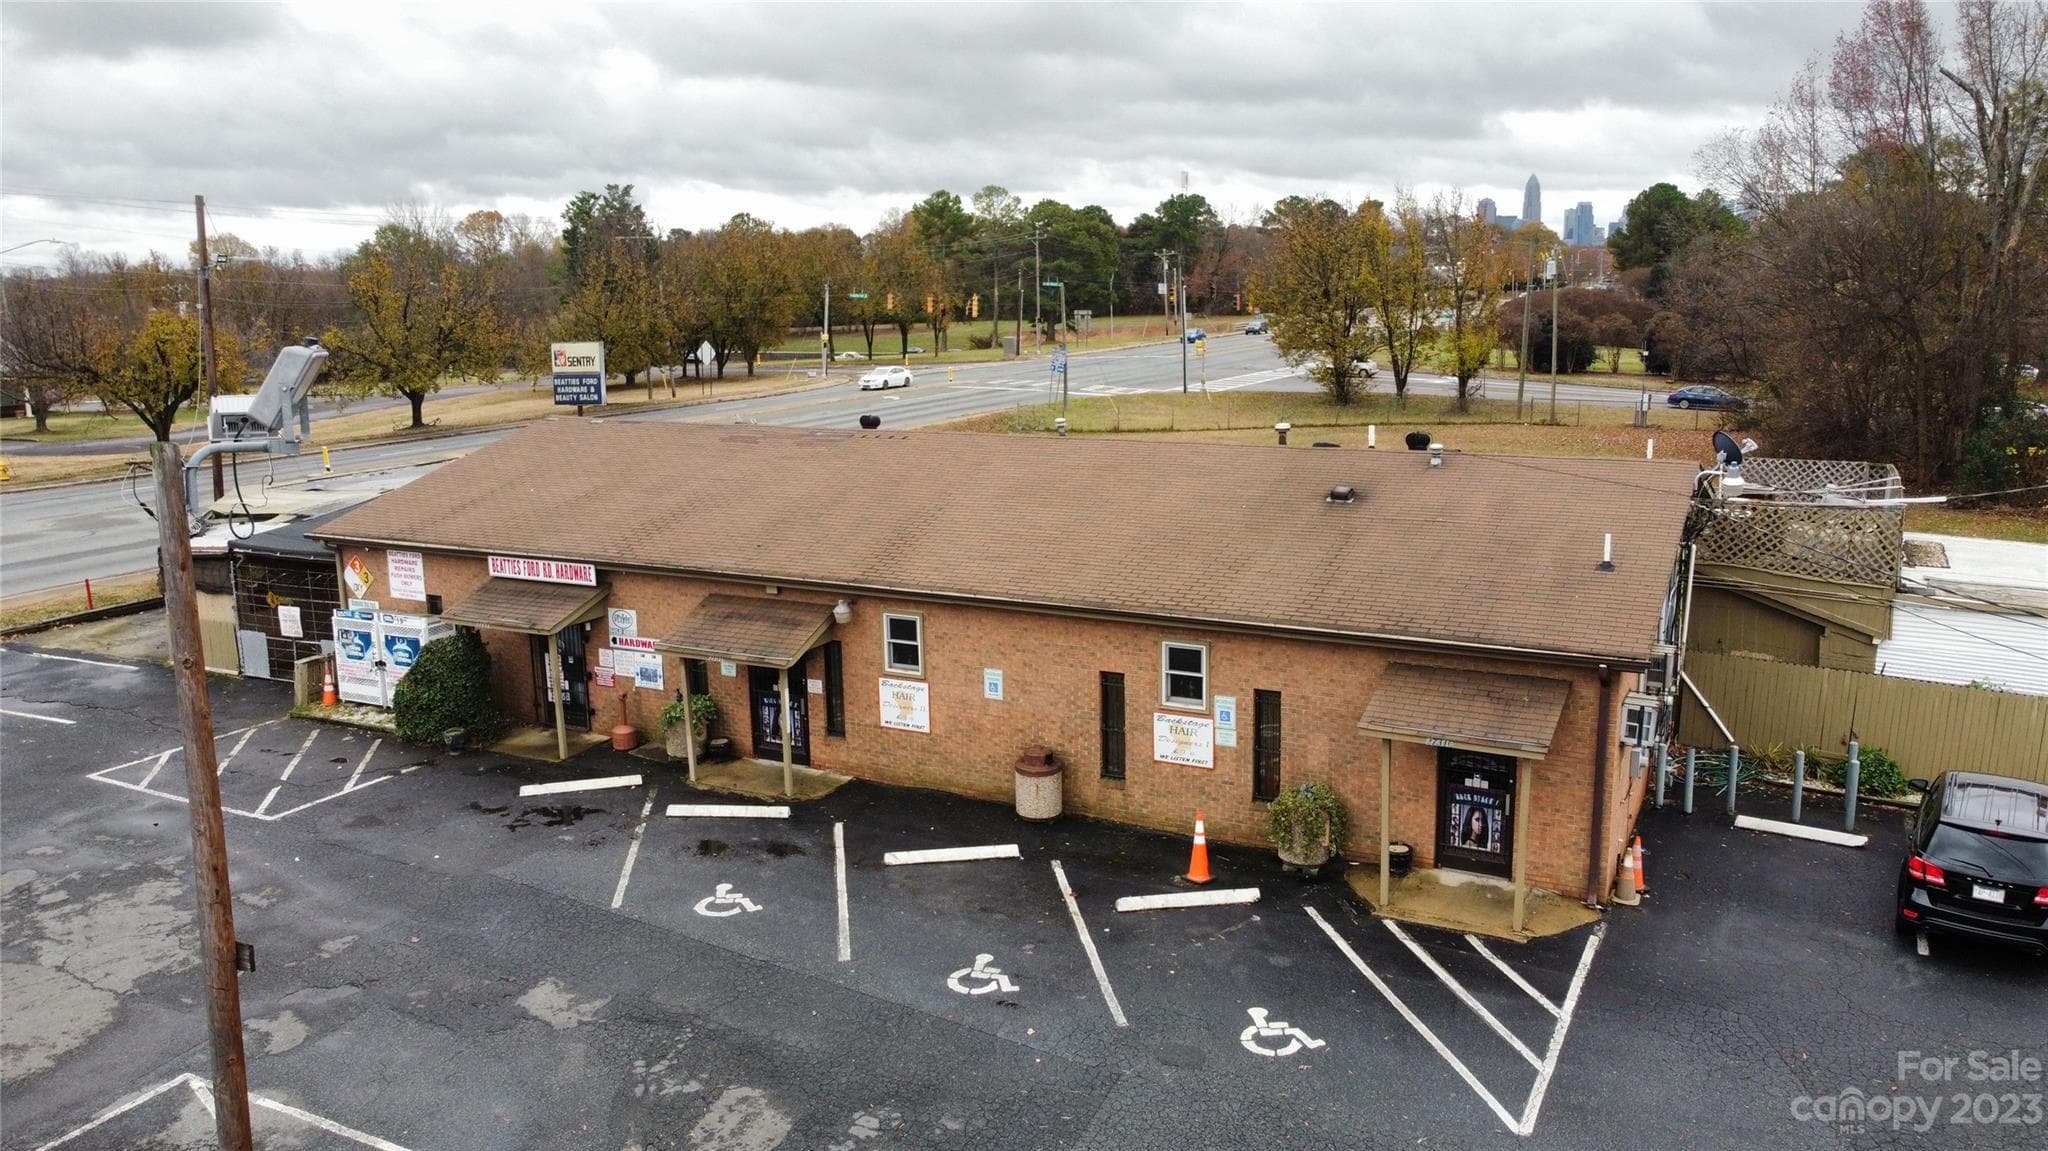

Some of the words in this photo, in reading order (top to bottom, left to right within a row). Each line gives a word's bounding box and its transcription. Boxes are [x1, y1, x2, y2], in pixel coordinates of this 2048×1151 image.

[567, 356, 596, 368] SENTRY
[554, 378, 580, 386] BEATTIES
[354, 560, 360, 573] 3
[491, 558, 521, 575] BEATTIES
[523, 560, 540, 577] FORD
[543, 562, 554, 579] RD.
[556, 563, 593, 582] HARDWARE
[363, 572, 369, 584] 3
[881, 680, 926, 692] Backstage
[892, 691, 916, 701] HAIR
[1157, 715, 1211, 729] Backstage
[1169, 725, 1199, 737] HAIR
